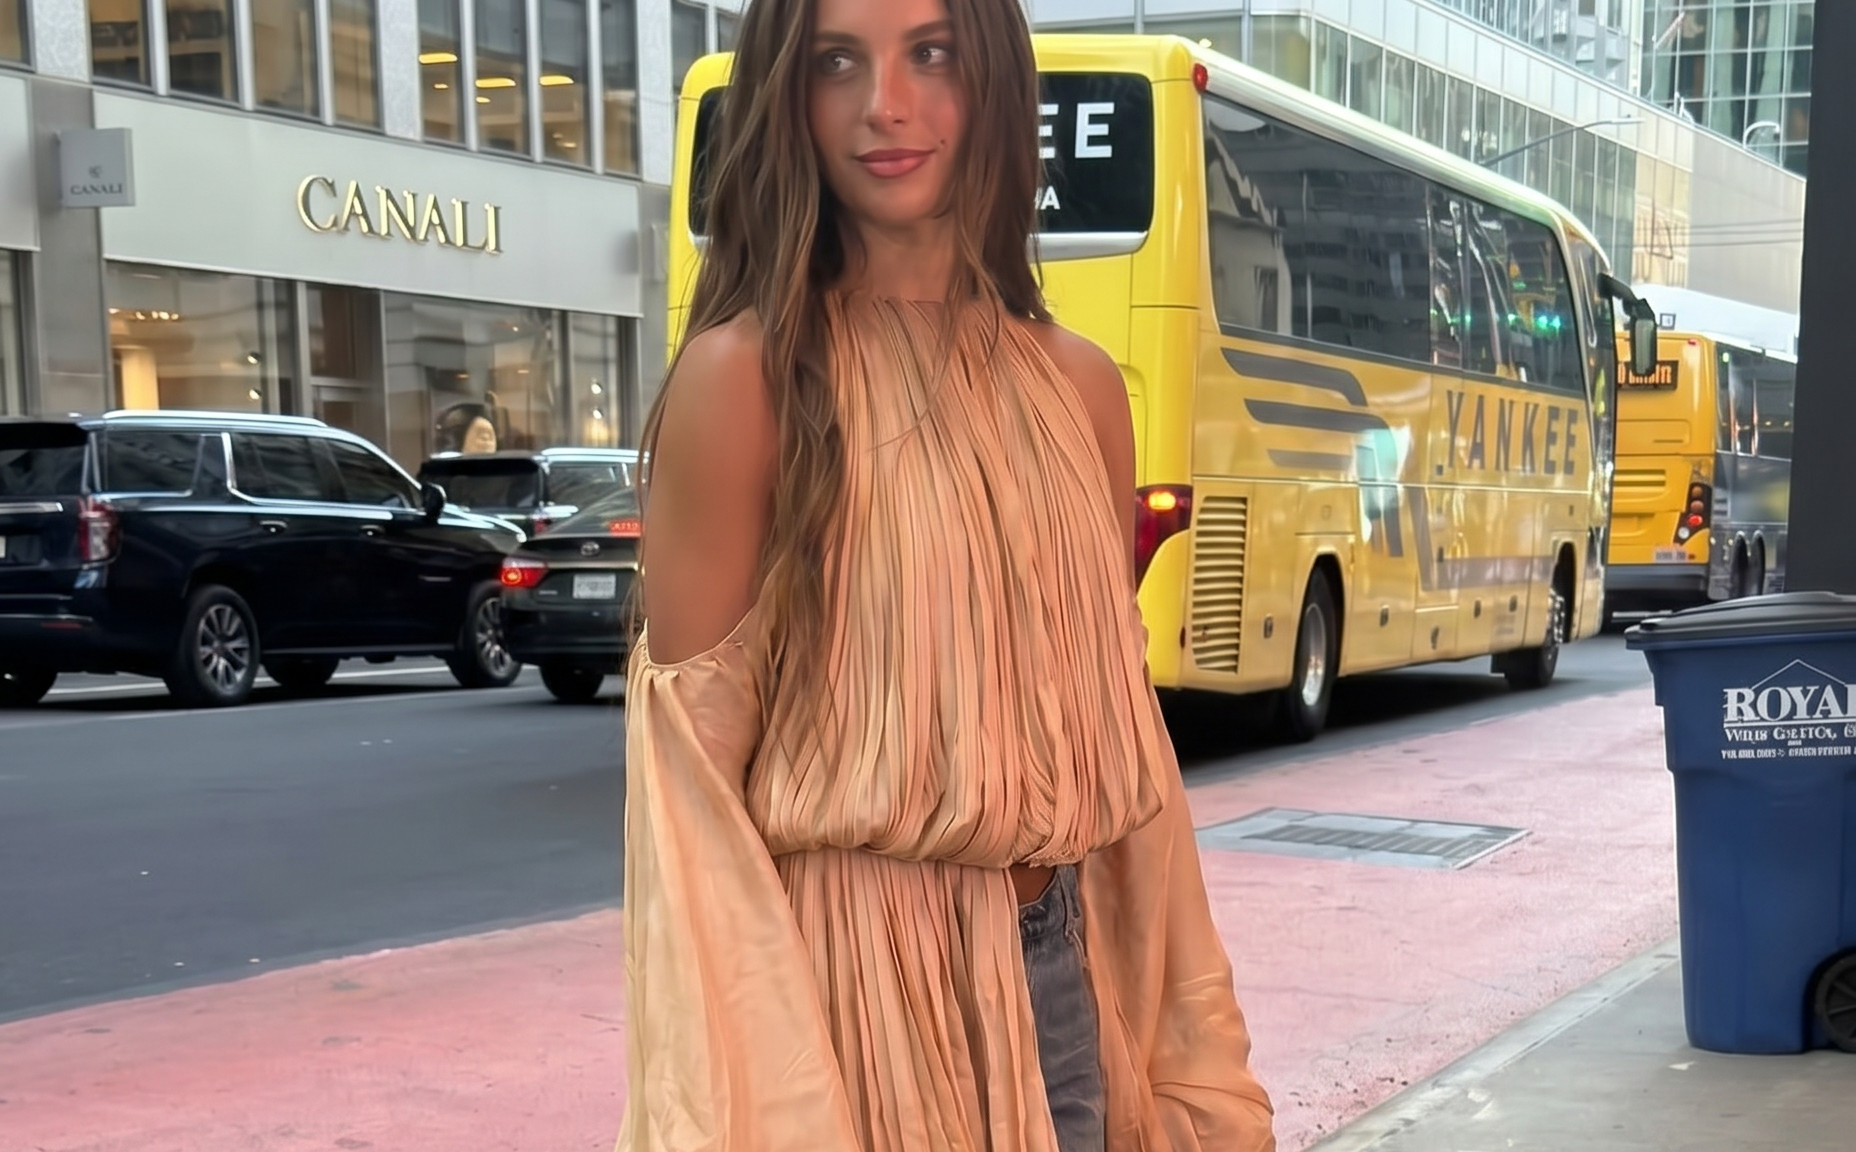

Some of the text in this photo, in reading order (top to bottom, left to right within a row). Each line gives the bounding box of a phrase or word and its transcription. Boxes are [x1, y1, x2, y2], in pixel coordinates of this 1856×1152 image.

[70, 183, 123, 195] CANALI
[297, 174, 503, 254] CANALI
[1447, 389, 1578, 475] YANKEE
